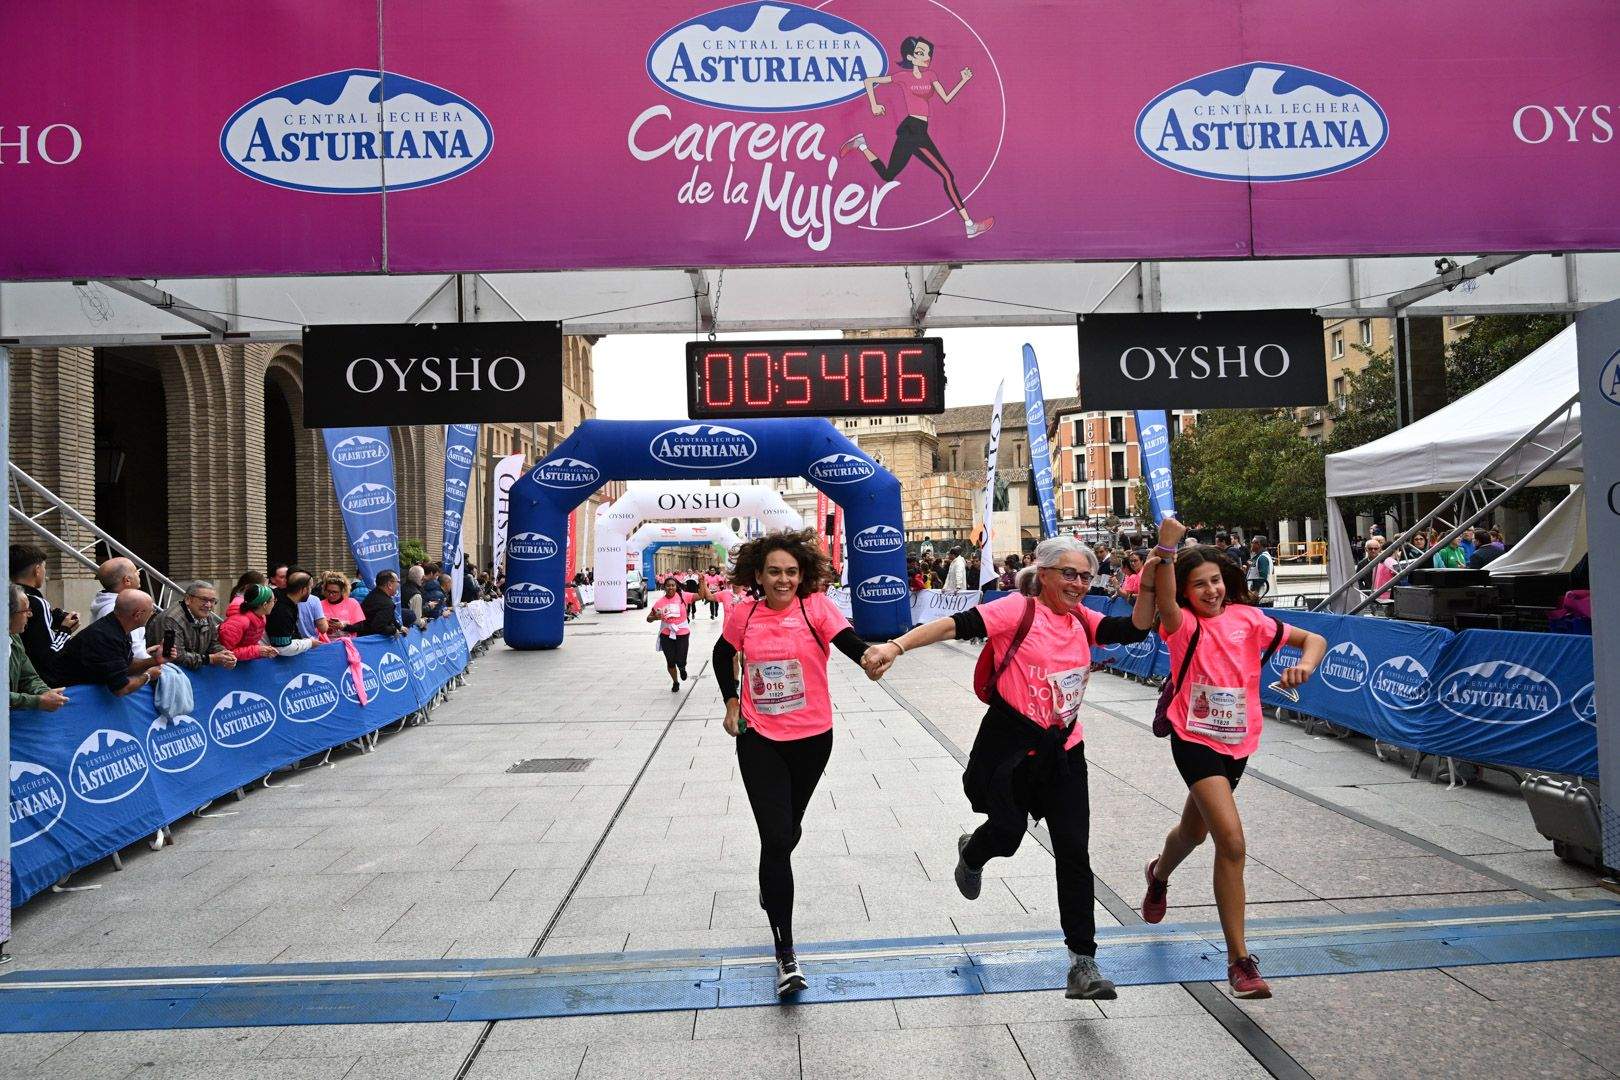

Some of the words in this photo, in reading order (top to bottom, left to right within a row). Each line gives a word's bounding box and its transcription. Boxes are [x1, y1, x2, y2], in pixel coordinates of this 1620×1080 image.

[703, 40, 779, 50] CENTRAL
[786, 39, 861, 50] LECHERA
[666, 42, 868, 83] ASTURIANA
[284, 113, 368, 125] CENTRAL
[376, 111, 464, 124] LECHERA
[1194, 104, 1273, 116] CENTRAL
[1281, 102, 1361, 114] LECHERA
[628, 105, 827, 162] Carrera
[1156, 108, 1370, 152] ASTURIANA
[1512, 104, 1620, 145] OYS
[241, 117, 473, 163] ASTURIANA
[677, 164, 714, 205] de
[722, 163, 749, 204] la
[744, 157, 901, 251] Mujer
[1119, 343, 1290, 381] OYSHO
[346, 356, 526, 393] OYSHO
[657, 438, 749, 458] ASTURIANA
[1086, 423, 1095, 464] HOTEL
[536, 469, 594, 482] ASTURIANA
[814, 465, 871, 478] ASTURIANA
[658, 492, 741, 510] OYSHO
[763, 508, 789, 516] OYSHO
[509, 541, 554, 554] ASTURIANA
[857, 537, 902, 548] ASTURIANA
[507, 591, 551, 604] ASTURIANA
[860, 586, 905, 597] ASTURIANA
[930, 593, 968, 612] OYSHO
[1027, 665, 1048, 681] TU
[1322, 656, 1364, 683] ASTURIANA
[766, 682, 785, 691] 016
[1443, 681, 1549, 712] ASTURIANA
[285, 690, 336, 716] ASTURIANA
[1211, 708, 1233, 719] 016
[214, 708, 273, 741] ASTURIANA
[86, 752, 112, 768] CENTRAL
[113, 743, 138, 758] LECHERA
[152, 732, 205, 763] ASTURIANA
[77, 752, 147, 795] ASTURIANA
[18, 776, 51, 794] LECHERA
